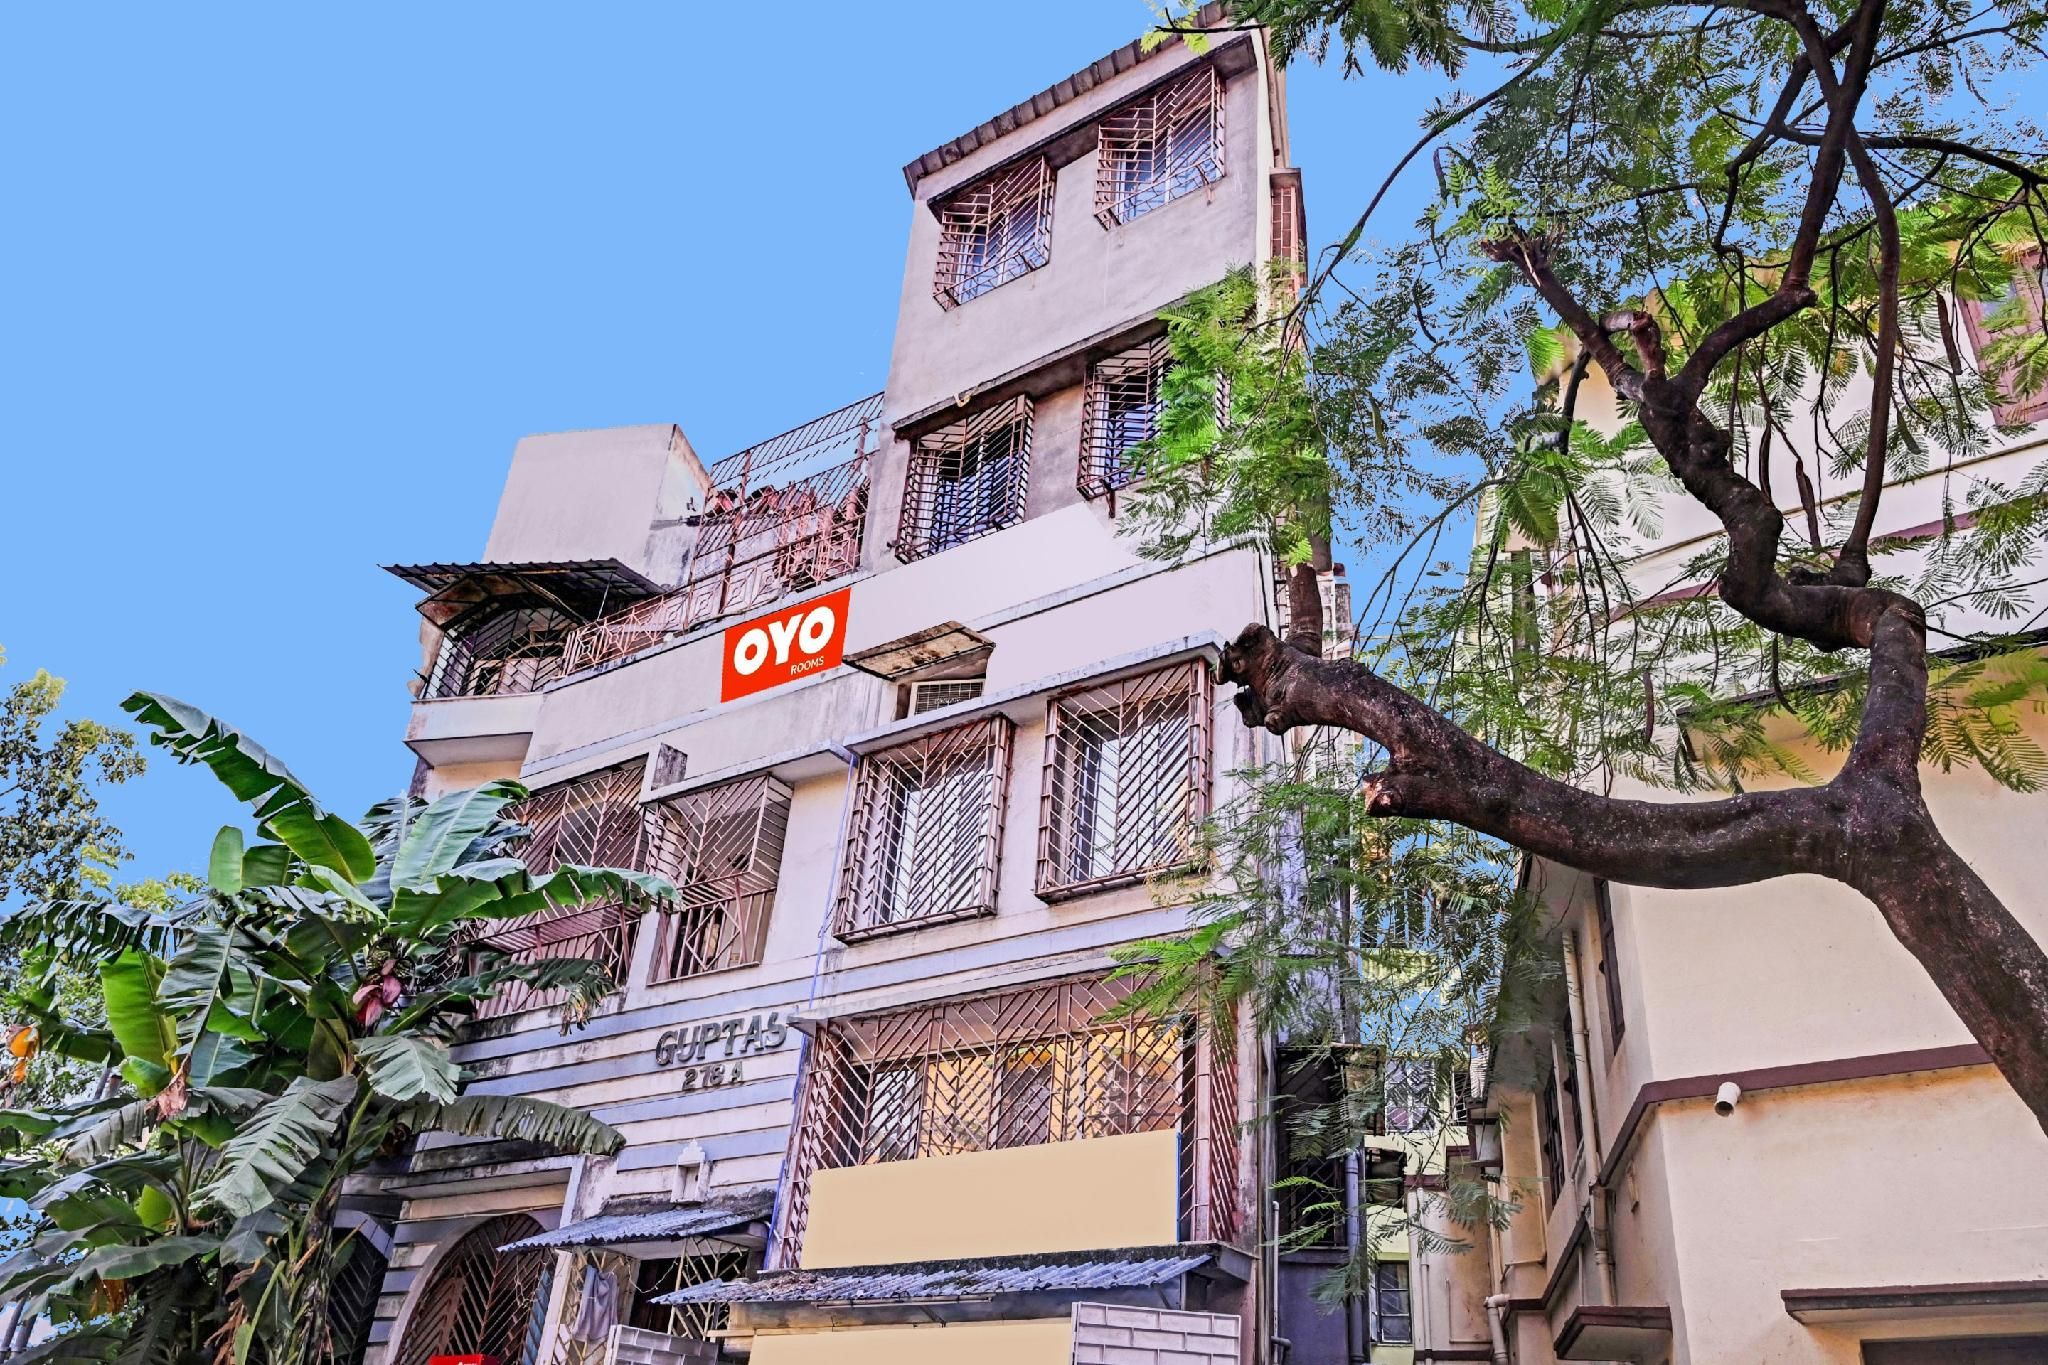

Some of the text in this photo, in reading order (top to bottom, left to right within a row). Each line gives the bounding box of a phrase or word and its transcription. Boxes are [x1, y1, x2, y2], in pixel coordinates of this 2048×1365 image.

[733, 606, 835, 676] OYO
[790, 656, 824, 675] ROOMS
[655, 1012, 787, 1065] GUPTAS
